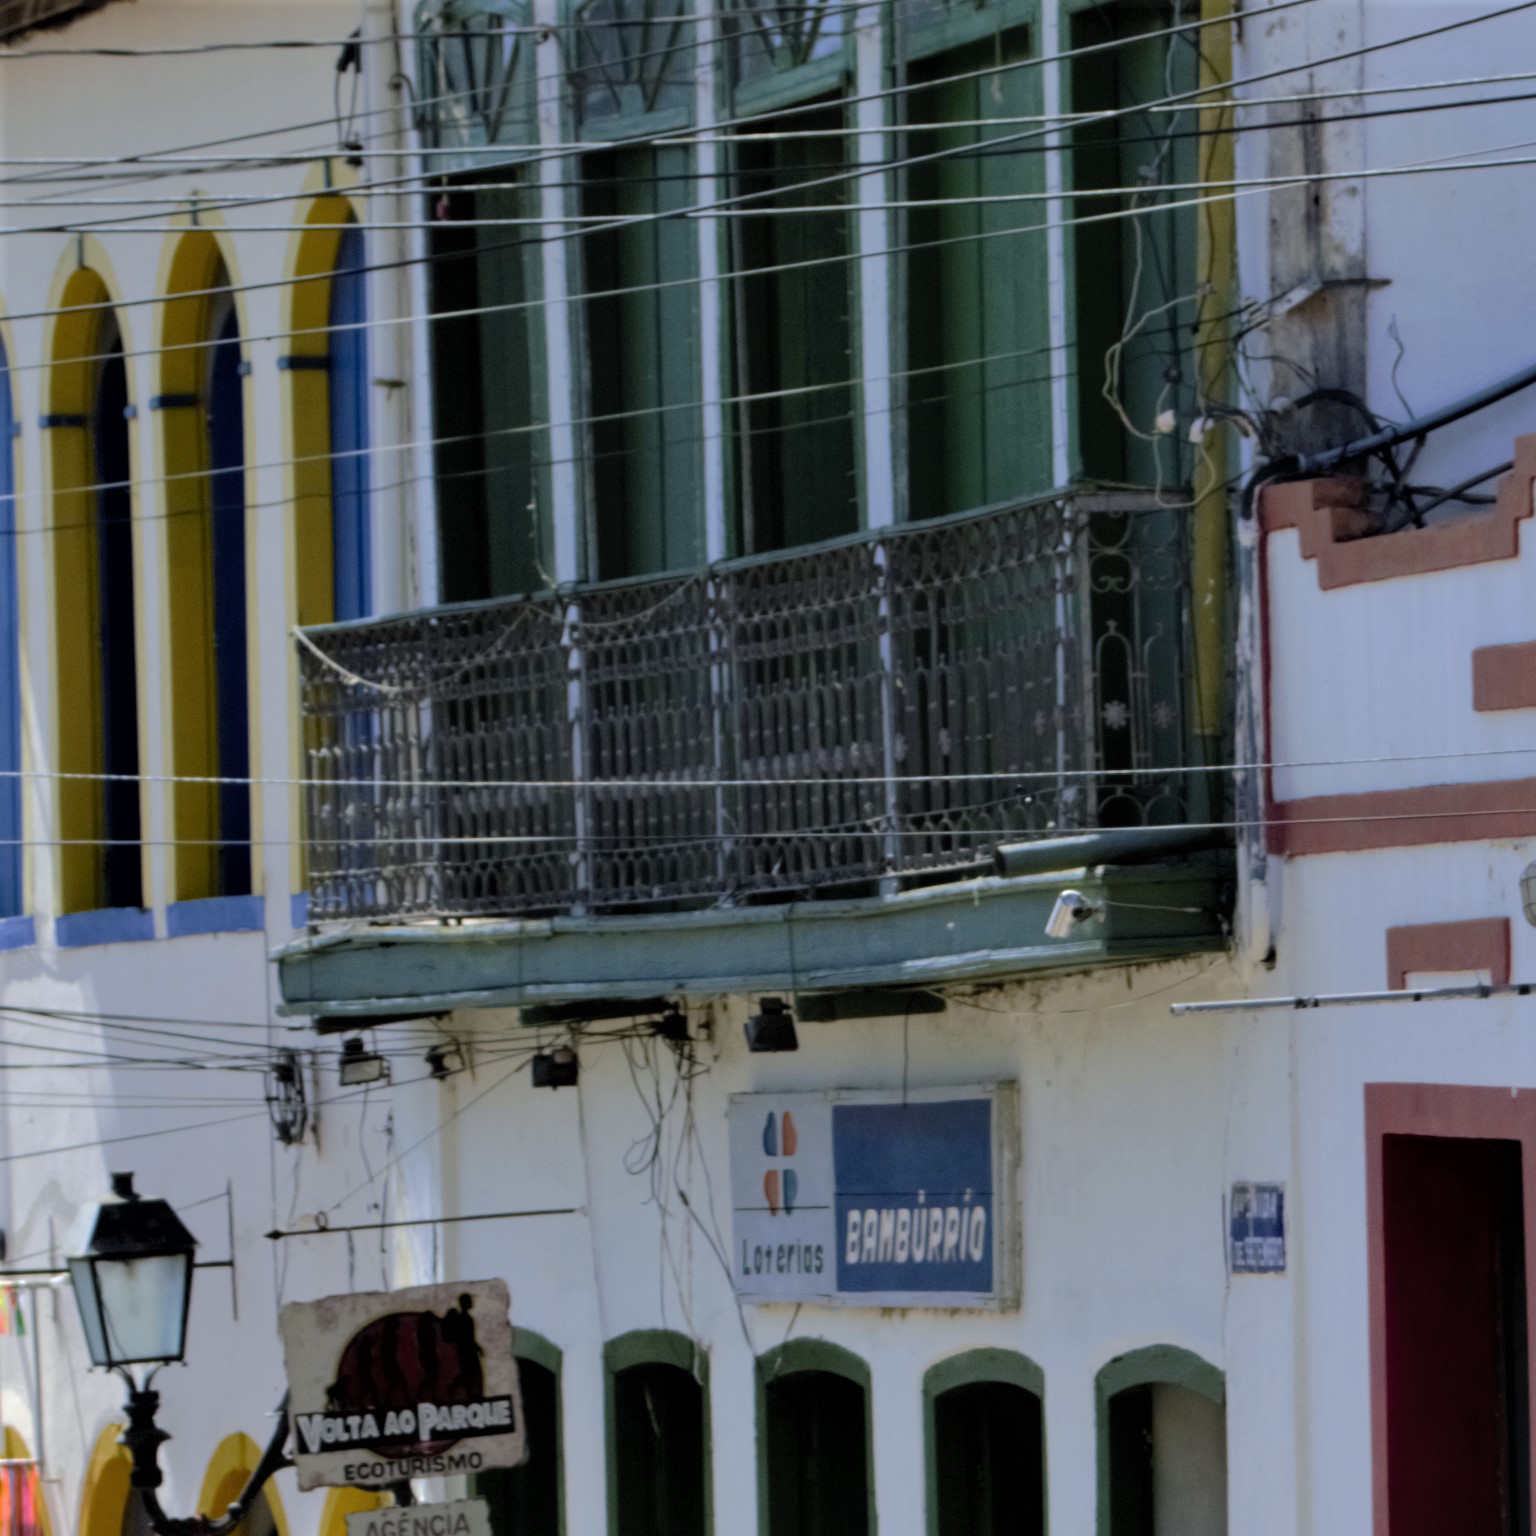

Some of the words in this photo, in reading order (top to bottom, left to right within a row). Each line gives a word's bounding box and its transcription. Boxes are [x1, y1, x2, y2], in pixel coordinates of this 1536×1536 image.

[742, 1238, 825, 1276] Loterias
[297, 1412, 381, 1454] VOLTA
[383, 1409, 417, 1436] AO
[417, 1399, 513, 1443] PARQUE
[343, 1451, 484, 1482] ECOTURISMO
